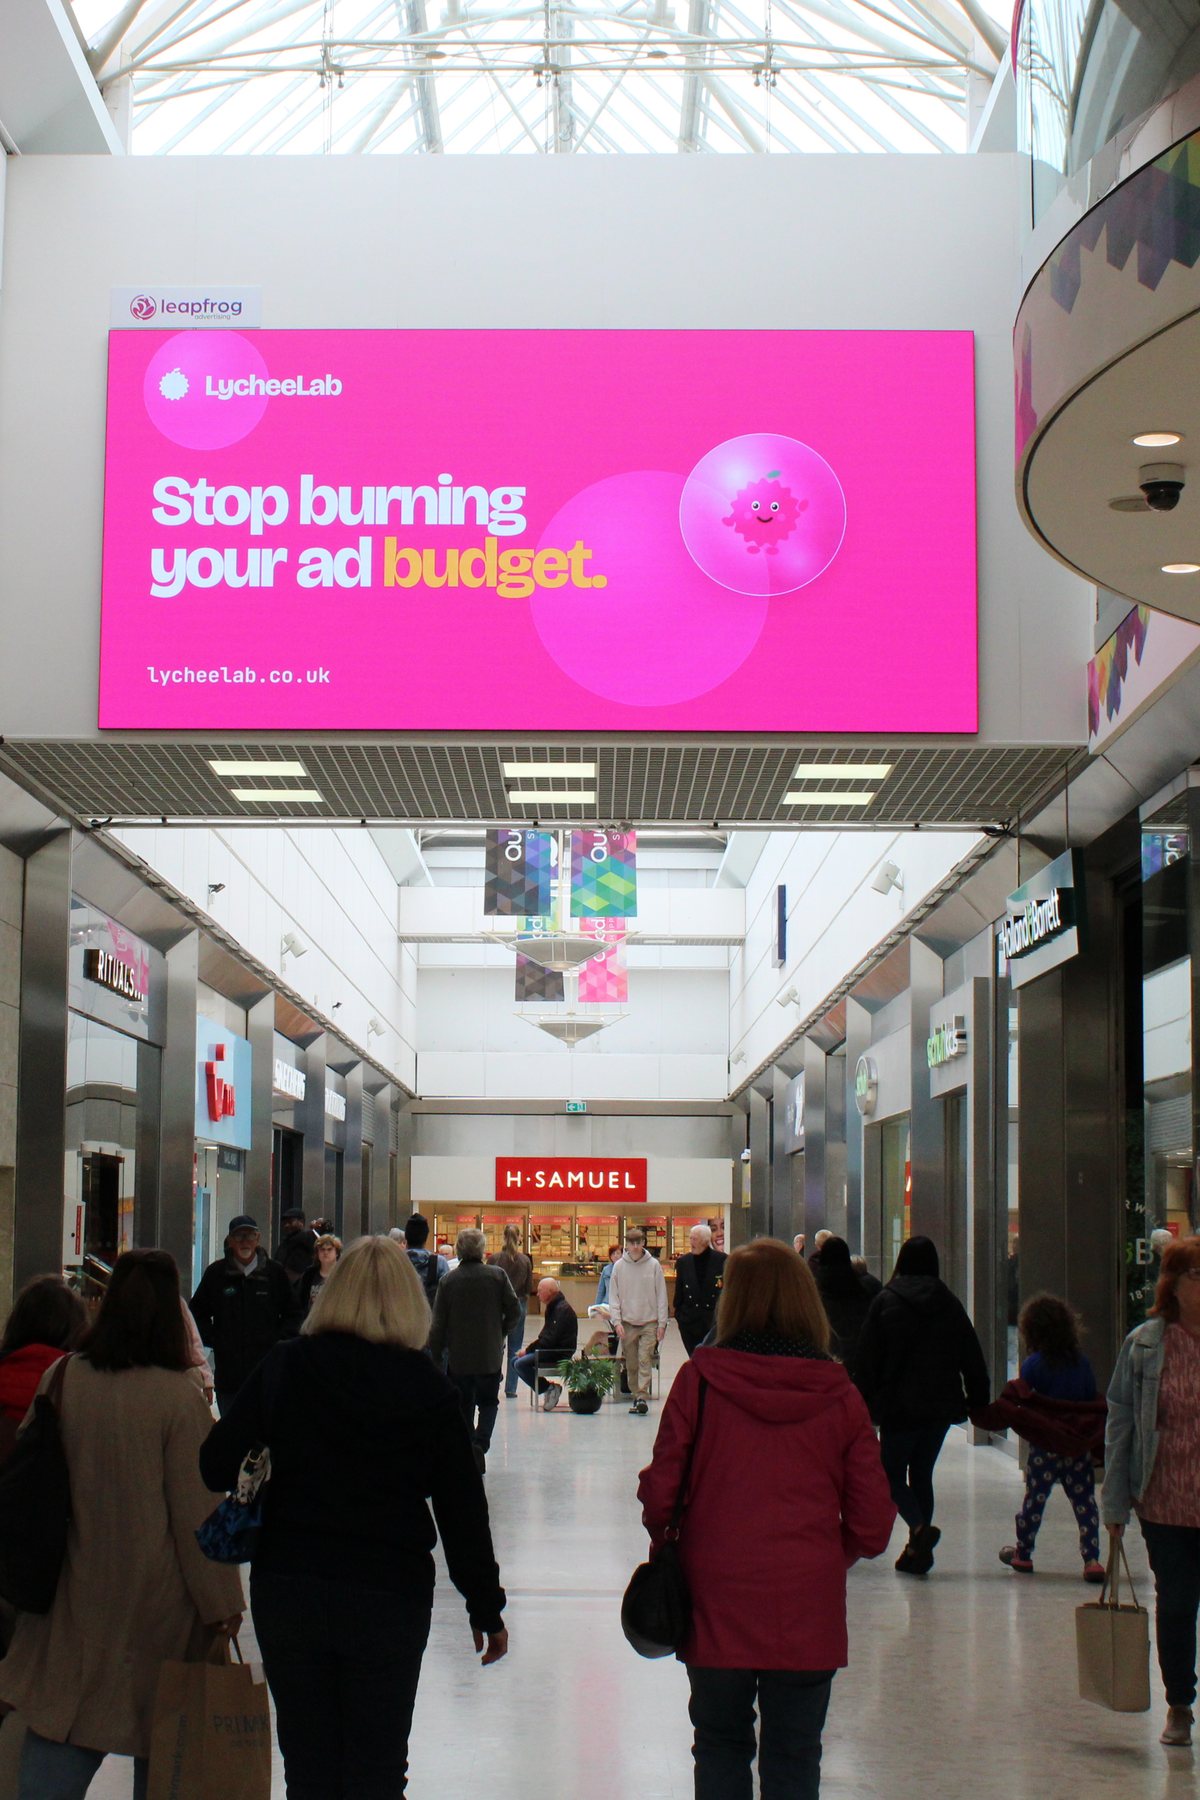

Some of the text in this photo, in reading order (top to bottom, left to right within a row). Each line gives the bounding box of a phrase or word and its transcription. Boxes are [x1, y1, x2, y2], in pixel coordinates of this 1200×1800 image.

[161, 298, 243, 316] leapfrog
[205, 374, 343, 400] LycheeLab
[151, 472, 527, 536] Stop burning
[150, 536, 608, 599] your ad budget.
[147, 666, 331, 686] lycheelab.co.uk
